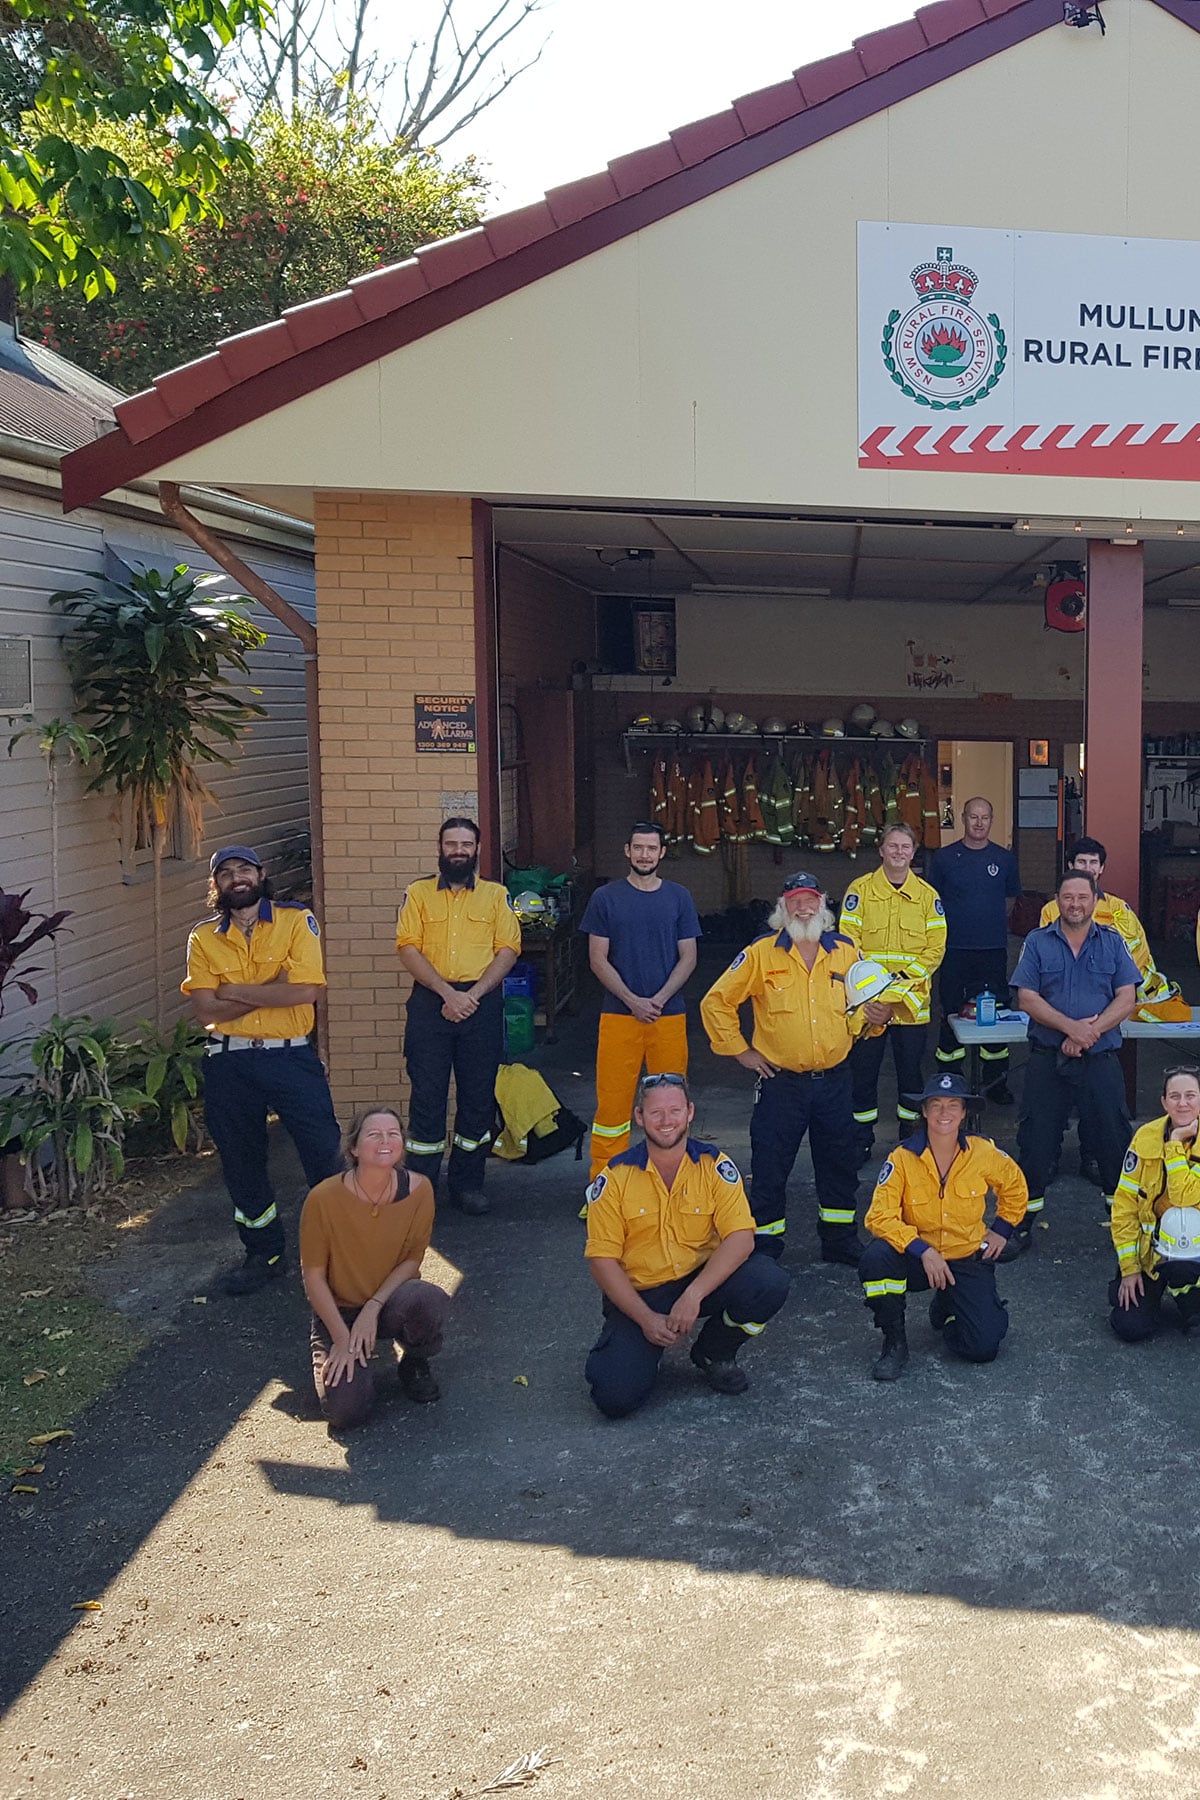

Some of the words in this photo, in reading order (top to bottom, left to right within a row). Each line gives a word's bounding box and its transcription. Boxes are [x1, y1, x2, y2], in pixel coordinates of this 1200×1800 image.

[903, 308, 936, 349] RURAL
[941, 305, 974, 326] FIRE
[955, 328, 986, 387] SERVICE
[1023, 338, 1132, 368] RURAL
[905, 357, 933, 386] NSW
[417, 719, 467, 729] ADVANCED
